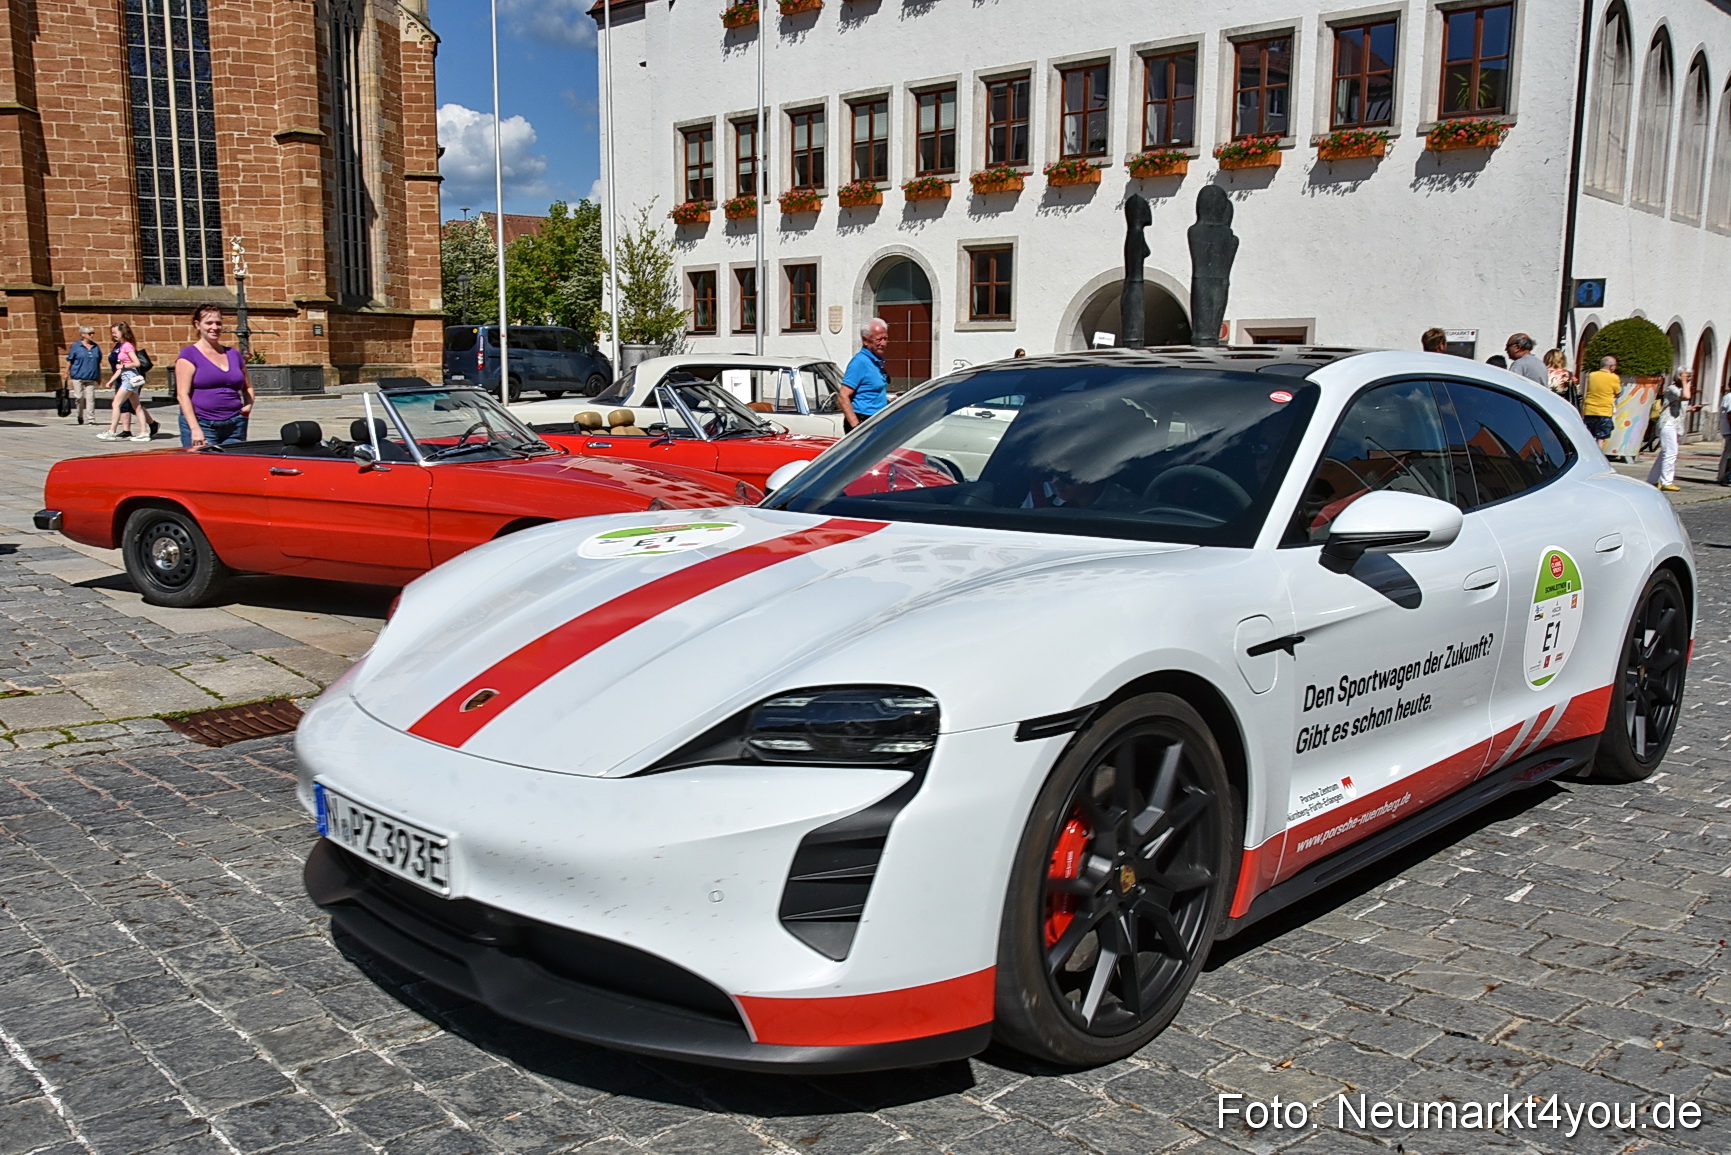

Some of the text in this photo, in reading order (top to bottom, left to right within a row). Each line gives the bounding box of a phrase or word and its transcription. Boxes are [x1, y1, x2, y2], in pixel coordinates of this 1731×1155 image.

[633, 535, 677, 547] E1
[1542, 620, 1561, 652] E1
[1303, 633, 1494, 712] Den Sportwagen der Zukunft?
[1296, 693, 1432, 755] Gibt es schon heute.
[1299, 783, 1339, 804] Porsche Zentrum
[1296, 791, 1412, 853] www.porsche-nuernberg.de
